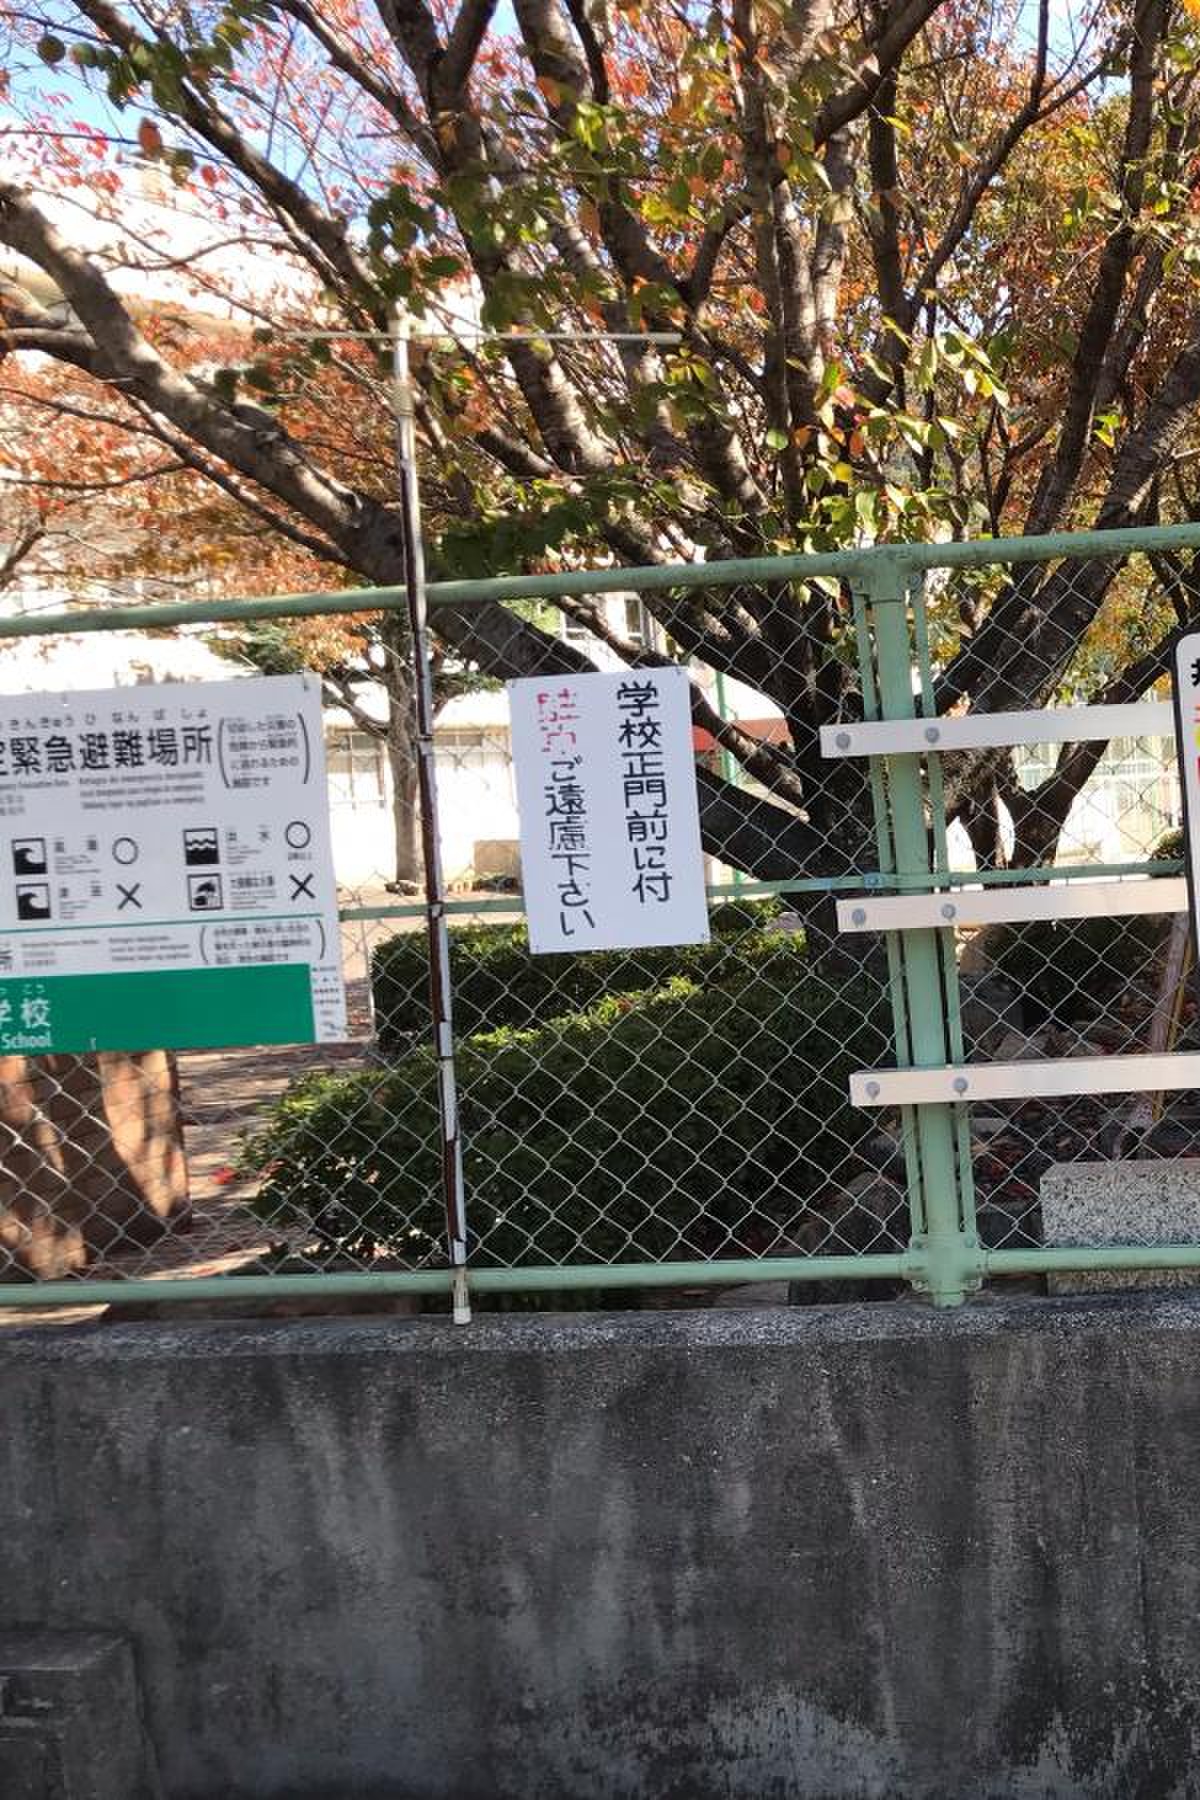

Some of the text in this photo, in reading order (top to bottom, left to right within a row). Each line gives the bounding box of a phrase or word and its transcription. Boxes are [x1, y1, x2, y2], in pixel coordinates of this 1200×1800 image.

[617, 680, 673, 904] 学校正門前に付
[1, 1032, 52, 1049] School
